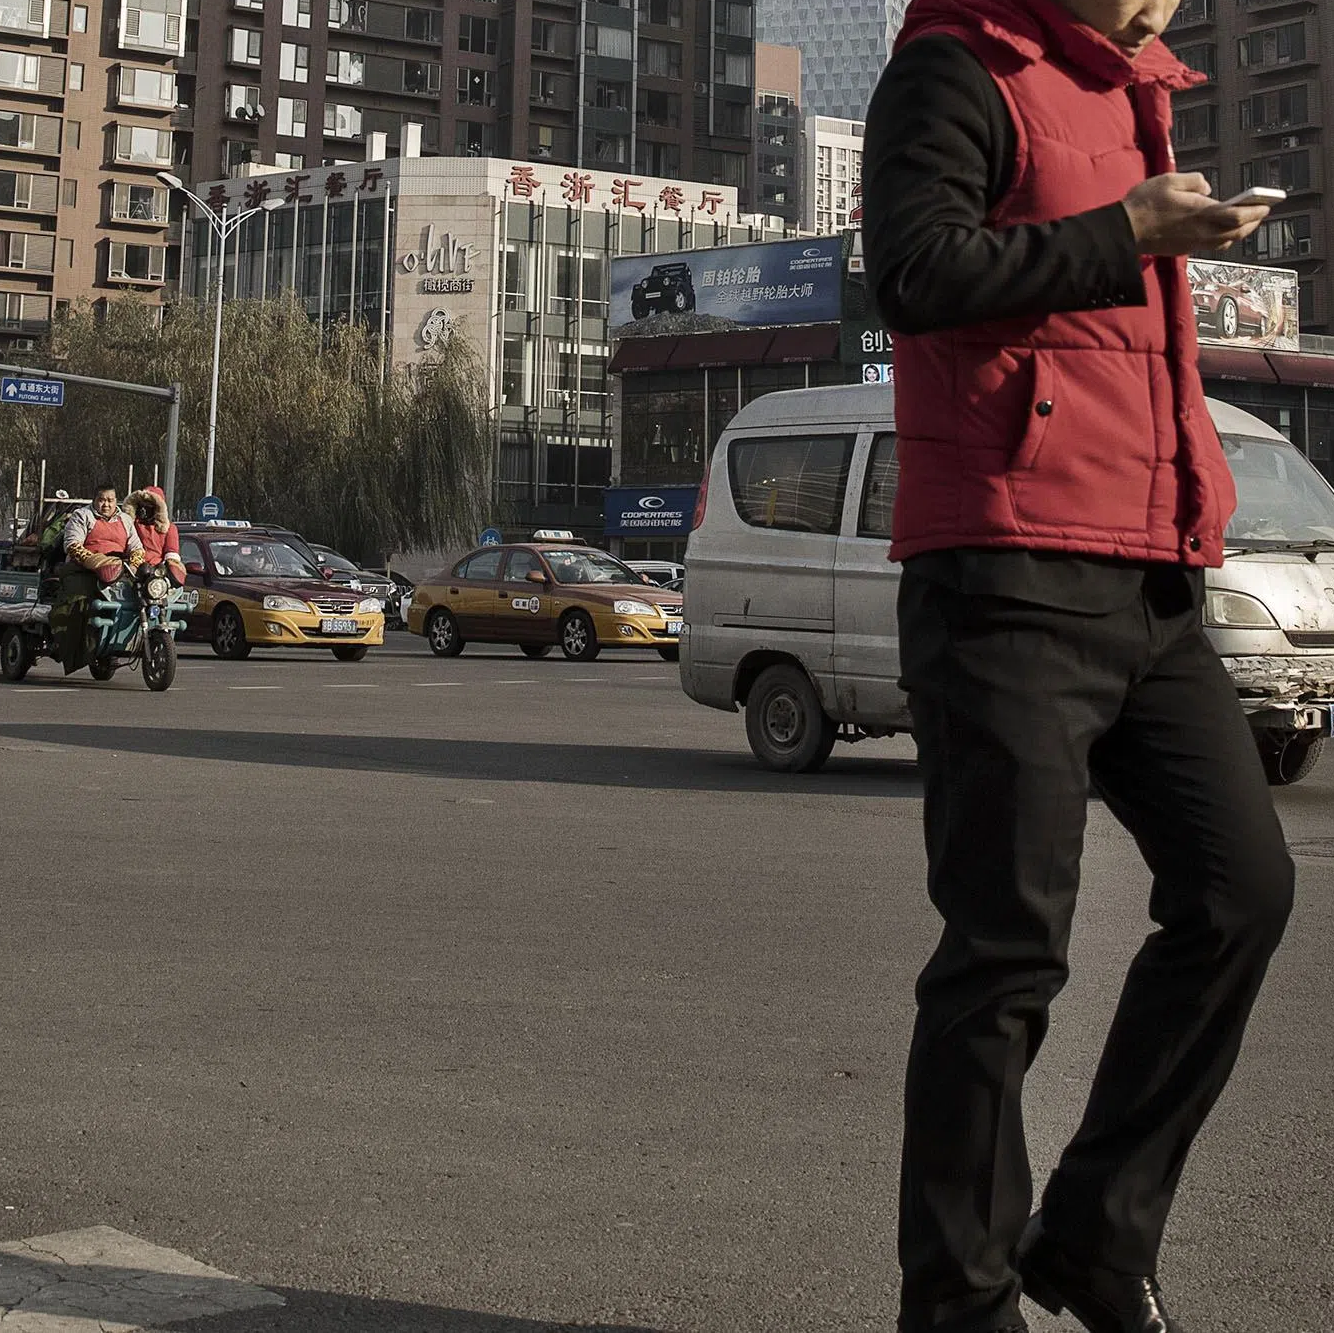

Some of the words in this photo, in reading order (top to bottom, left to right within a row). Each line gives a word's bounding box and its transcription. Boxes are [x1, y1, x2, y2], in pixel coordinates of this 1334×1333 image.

[506, 166, 724, 215] 香浙汇餐厅
[423, 278, 474, 293] 橄榄商街
[701, 266, 761, 287] 固铂轮胎
[716, 283, 814, 304] 全球越野轮胎大师
[19, 382, 59, 395] 阜通东大街
